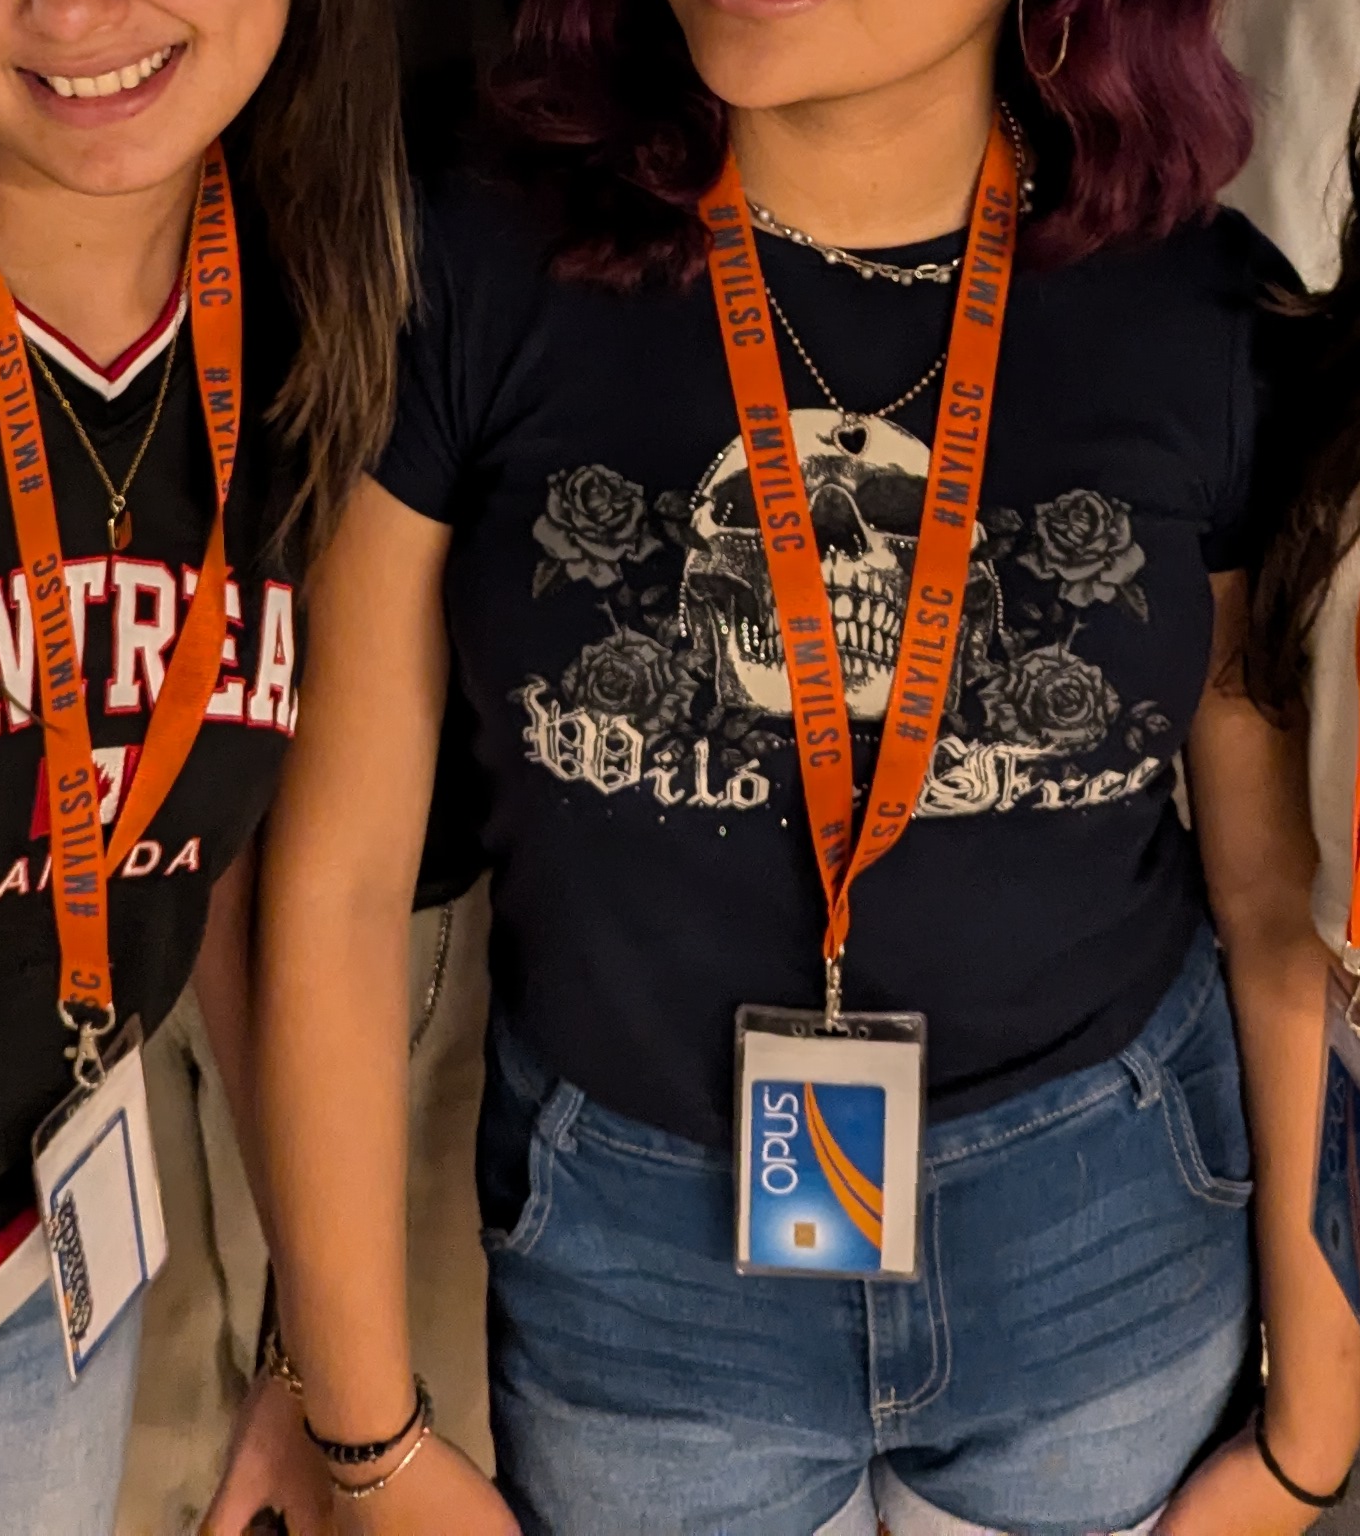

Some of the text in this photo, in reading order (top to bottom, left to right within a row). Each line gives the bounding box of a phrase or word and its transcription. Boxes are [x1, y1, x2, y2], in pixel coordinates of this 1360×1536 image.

[707, 203, 766, 348] #MYILSC
[964, 184, 1013, 329] #MYILSC
[203, 367, 236, 494] #MYIL
[744, 402, 806, 554] #MYILSC
[932, 379, 985, 528] #MYILSC
[32, 552, 78, 713] #MYILSC
[787, 615, 842, 769] #MYILSC
[895, 584, 955, 743] #MYILSC
[58, 767, 100, 919] #MYILSC
[761, 1092, 799, 1195] OPUS
